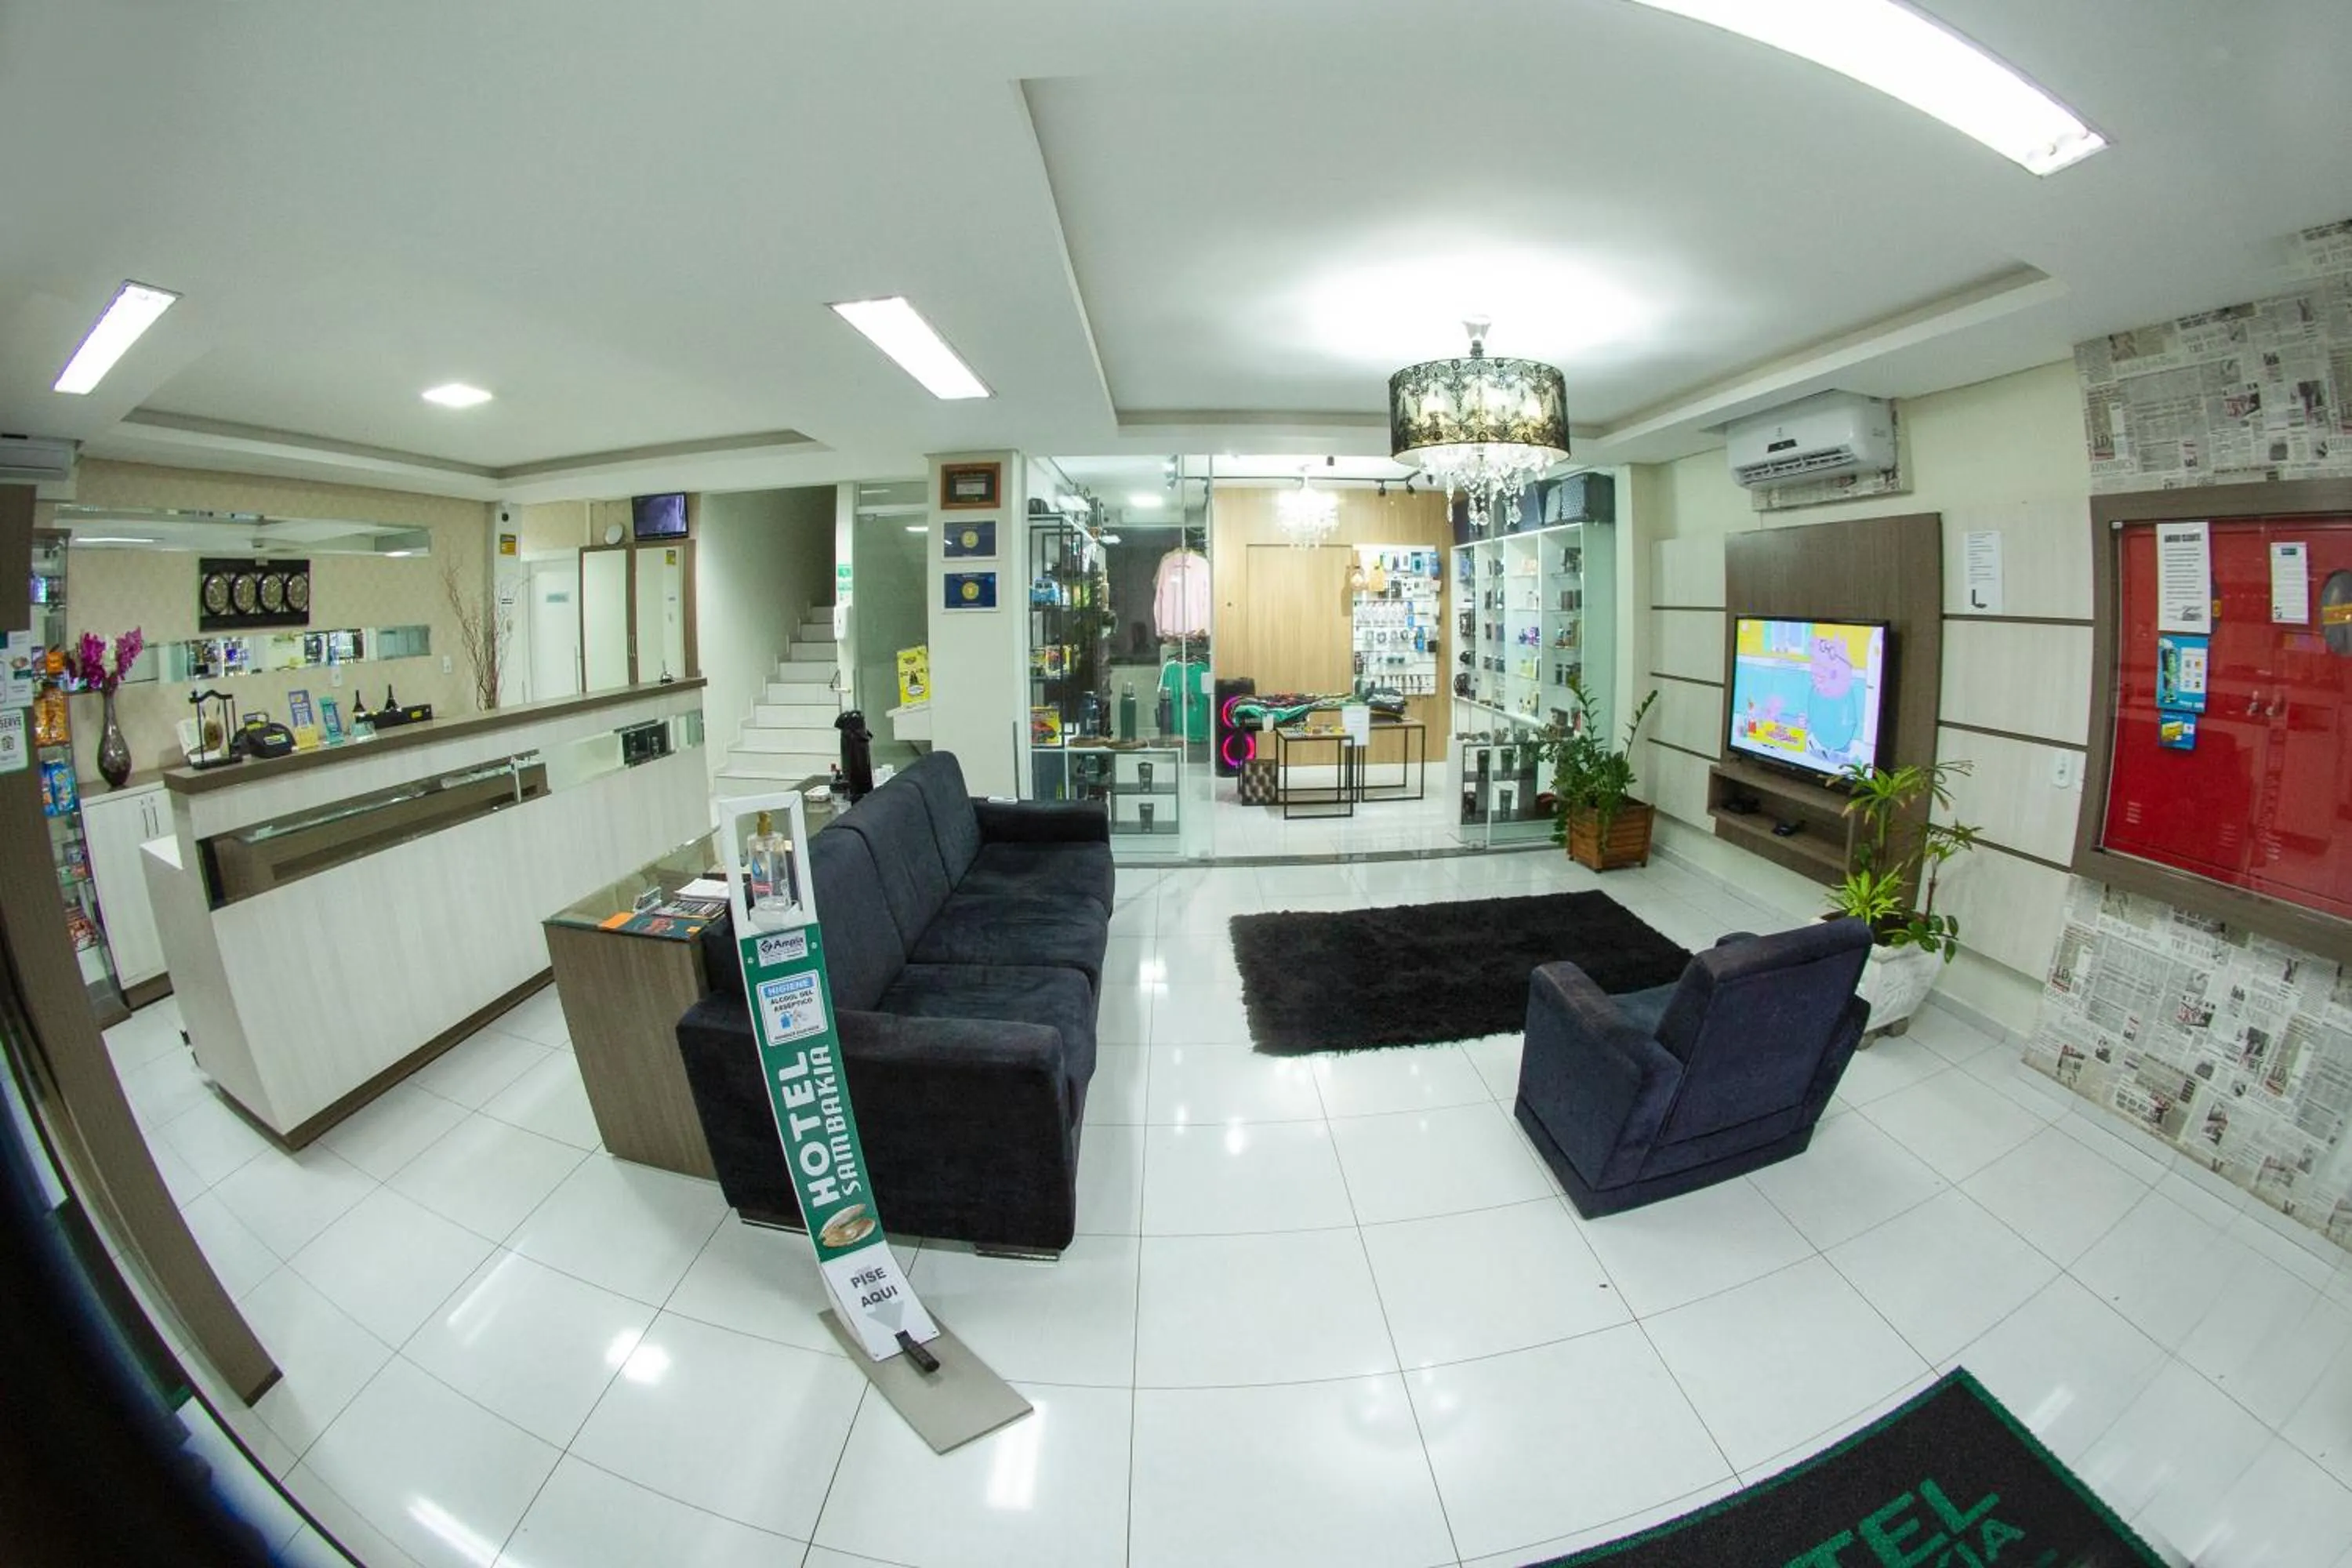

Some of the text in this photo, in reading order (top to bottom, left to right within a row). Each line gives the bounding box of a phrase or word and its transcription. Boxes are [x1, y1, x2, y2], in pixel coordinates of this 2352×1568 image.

[768, 978, 811, 996] HIGIENE
[779, 1051, 841, 1208] HOTEL
[810, 1044, 862, 1196] SAMBAKIA
[851, 1267, 887, 1288] PISE
[861, 1285, 898, 1308] AQUI
